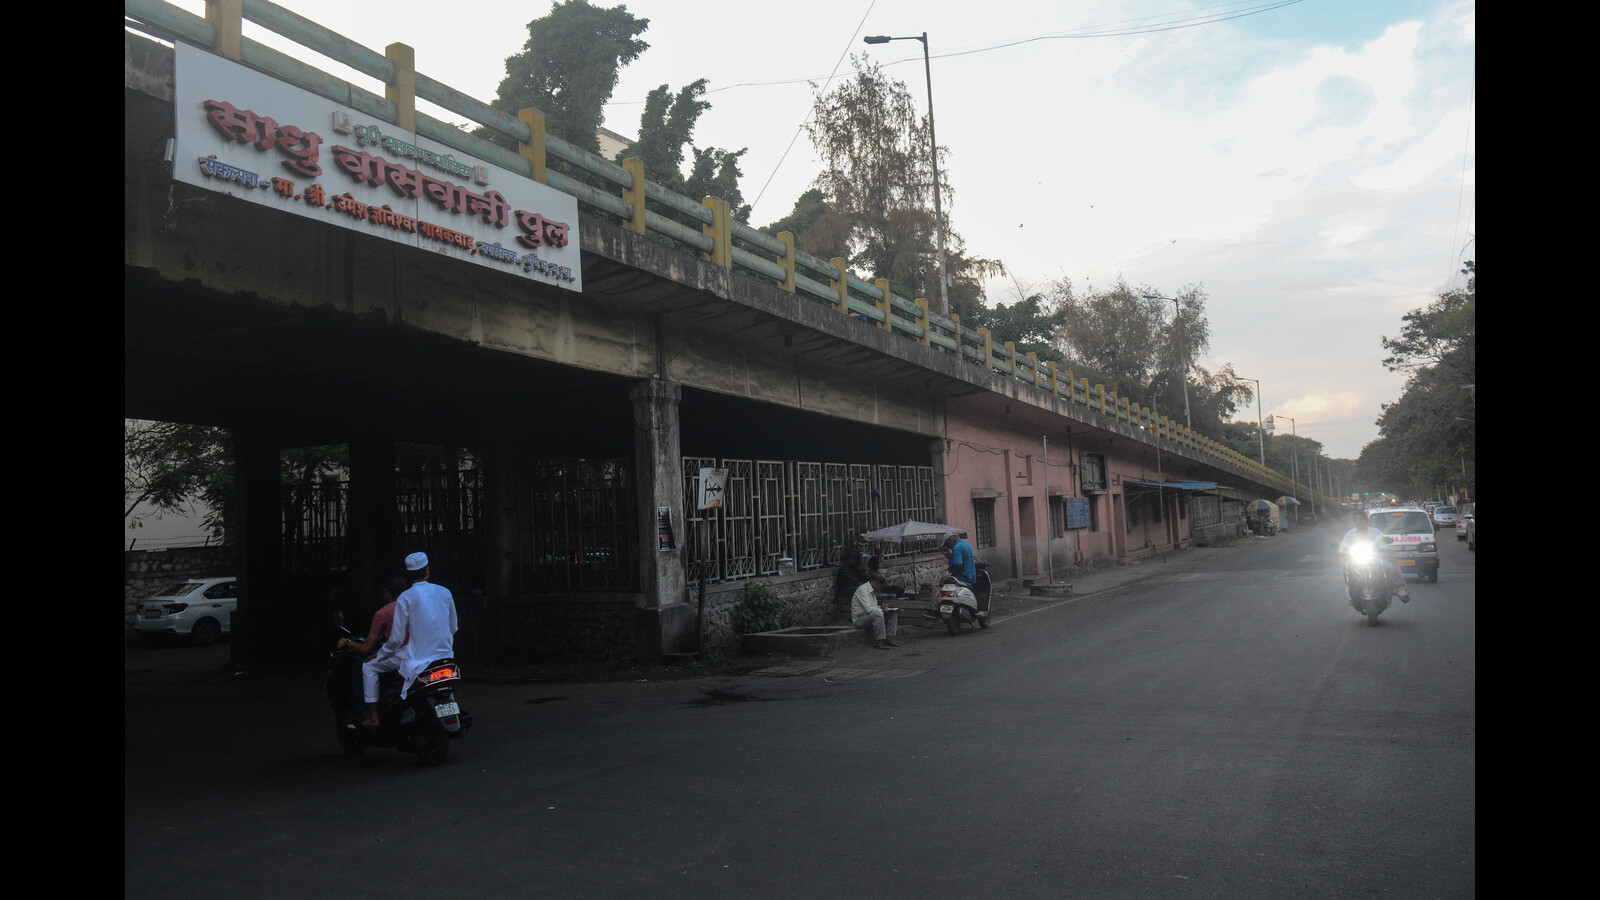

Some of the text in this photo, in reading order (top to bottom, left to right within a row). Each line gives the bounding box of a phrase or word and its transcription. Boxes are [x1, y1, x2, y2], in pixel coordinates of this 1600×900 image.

[204, 99, 570, 248] साधु वासवानी पुल
[355, 125, 474, 180] पुणे महानगरपालिका
[199, 155, 260, 189] संकल्पना
[332, 192, 368, 220] उमेश
[368, 204, 417, 233] ज्ञानेश्वर
